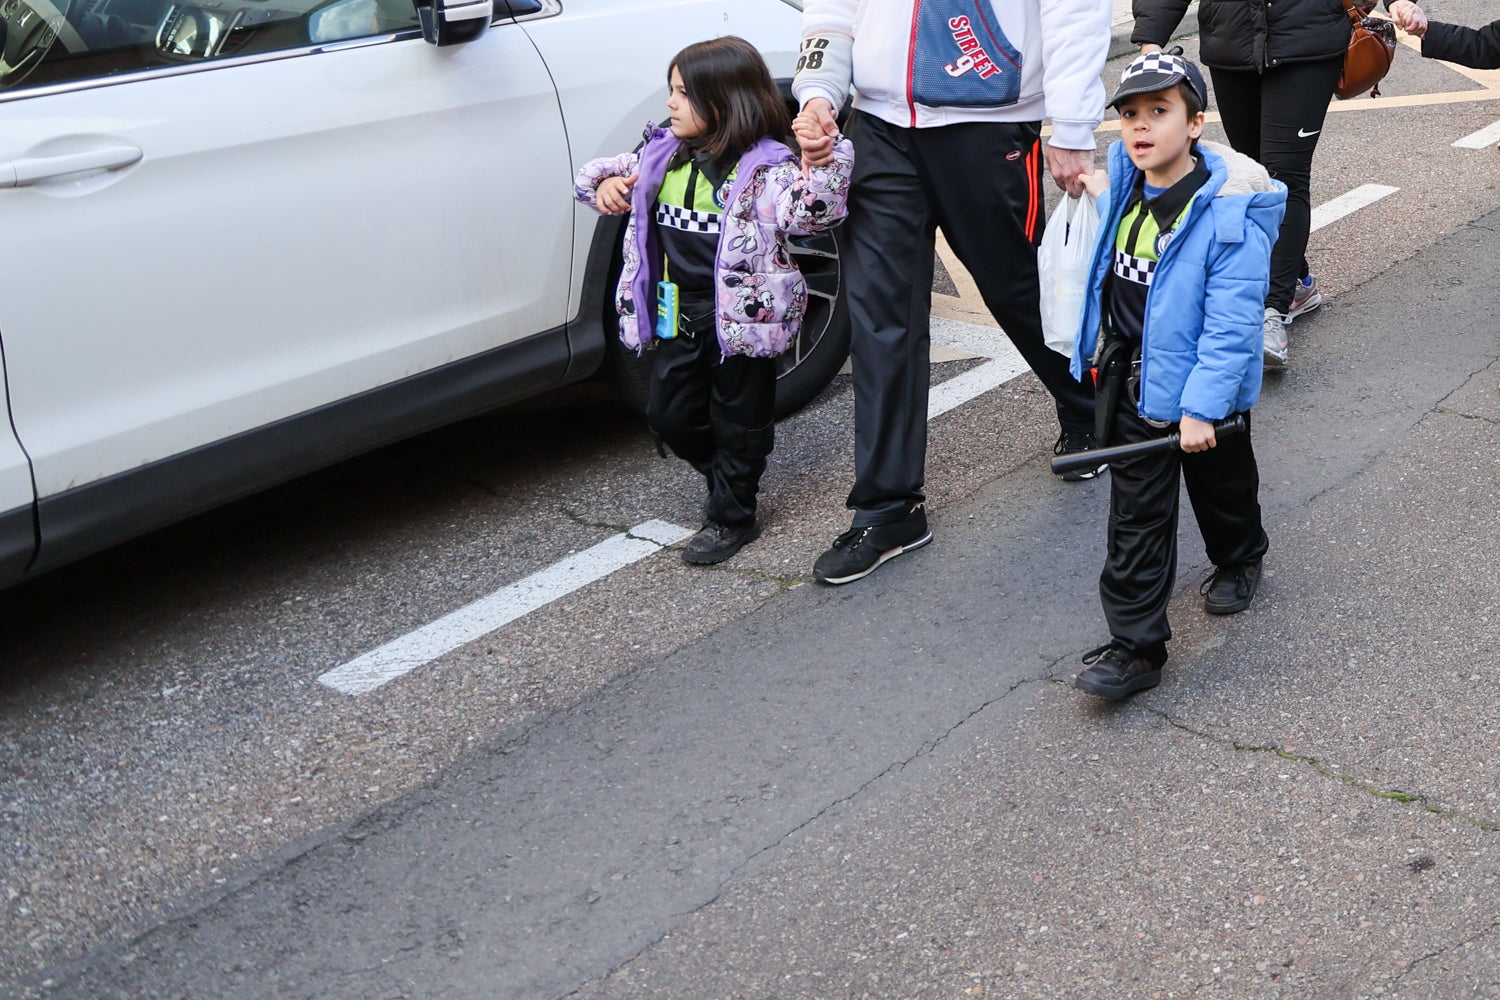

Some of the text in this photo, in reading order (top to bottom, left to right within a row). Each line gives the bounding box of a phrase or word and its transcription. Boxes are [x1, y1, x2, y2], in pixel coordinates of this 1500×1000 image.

[800, 37, 830, 53] TD
[948, 14, 1003, 81] STREET
[943, 54, 976, 79] 9
